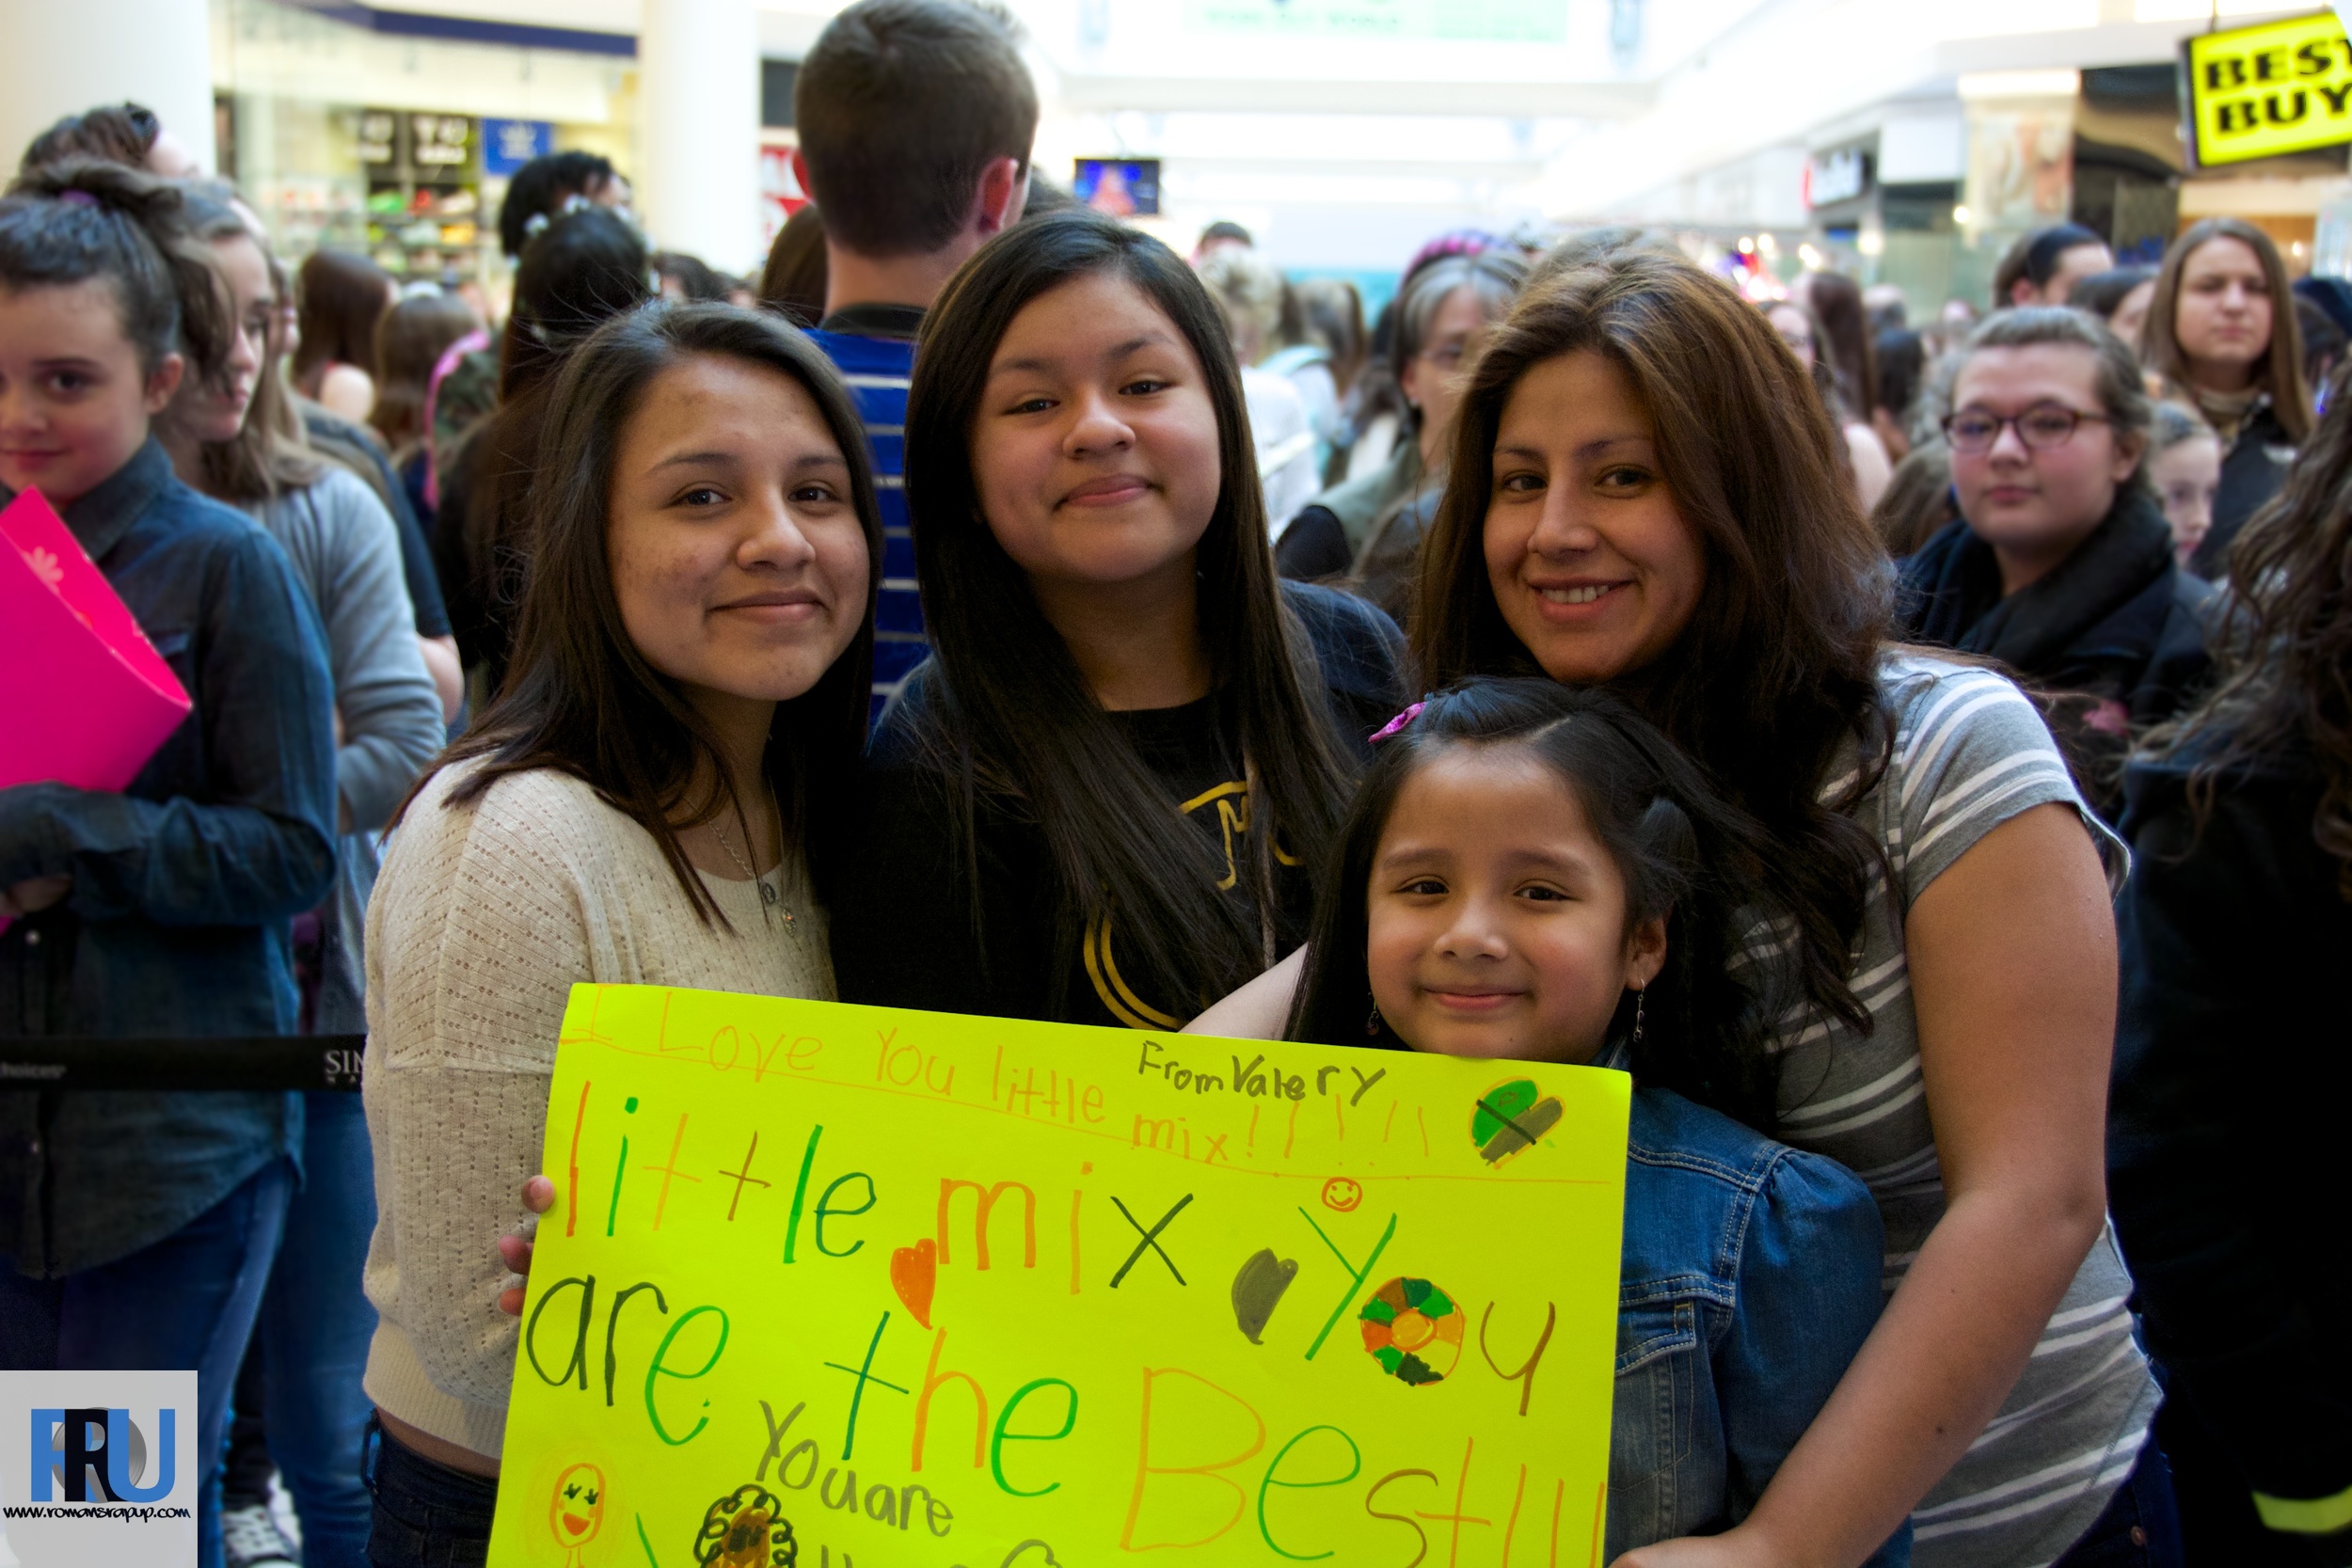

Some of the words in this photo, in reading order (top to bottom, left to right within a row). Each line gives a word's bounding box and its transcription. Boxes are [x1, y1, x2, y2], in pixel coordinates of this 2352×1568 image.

[2217, 83, 2352, 132] BUY
[659, 991, 822, 1083] Love
[876, 1026, 955, 1096] You
[992, 1044, 1105, 1124] little
[565, 1081, 877, 1263] little
[937, 1162, 1194, 1294] mix
[526, 1275, 730, 1446] are
[824, 1311, 1079, 1497] the
[755, 1400, 859, 1513] You
[865, 1483, 954, 1537] are
